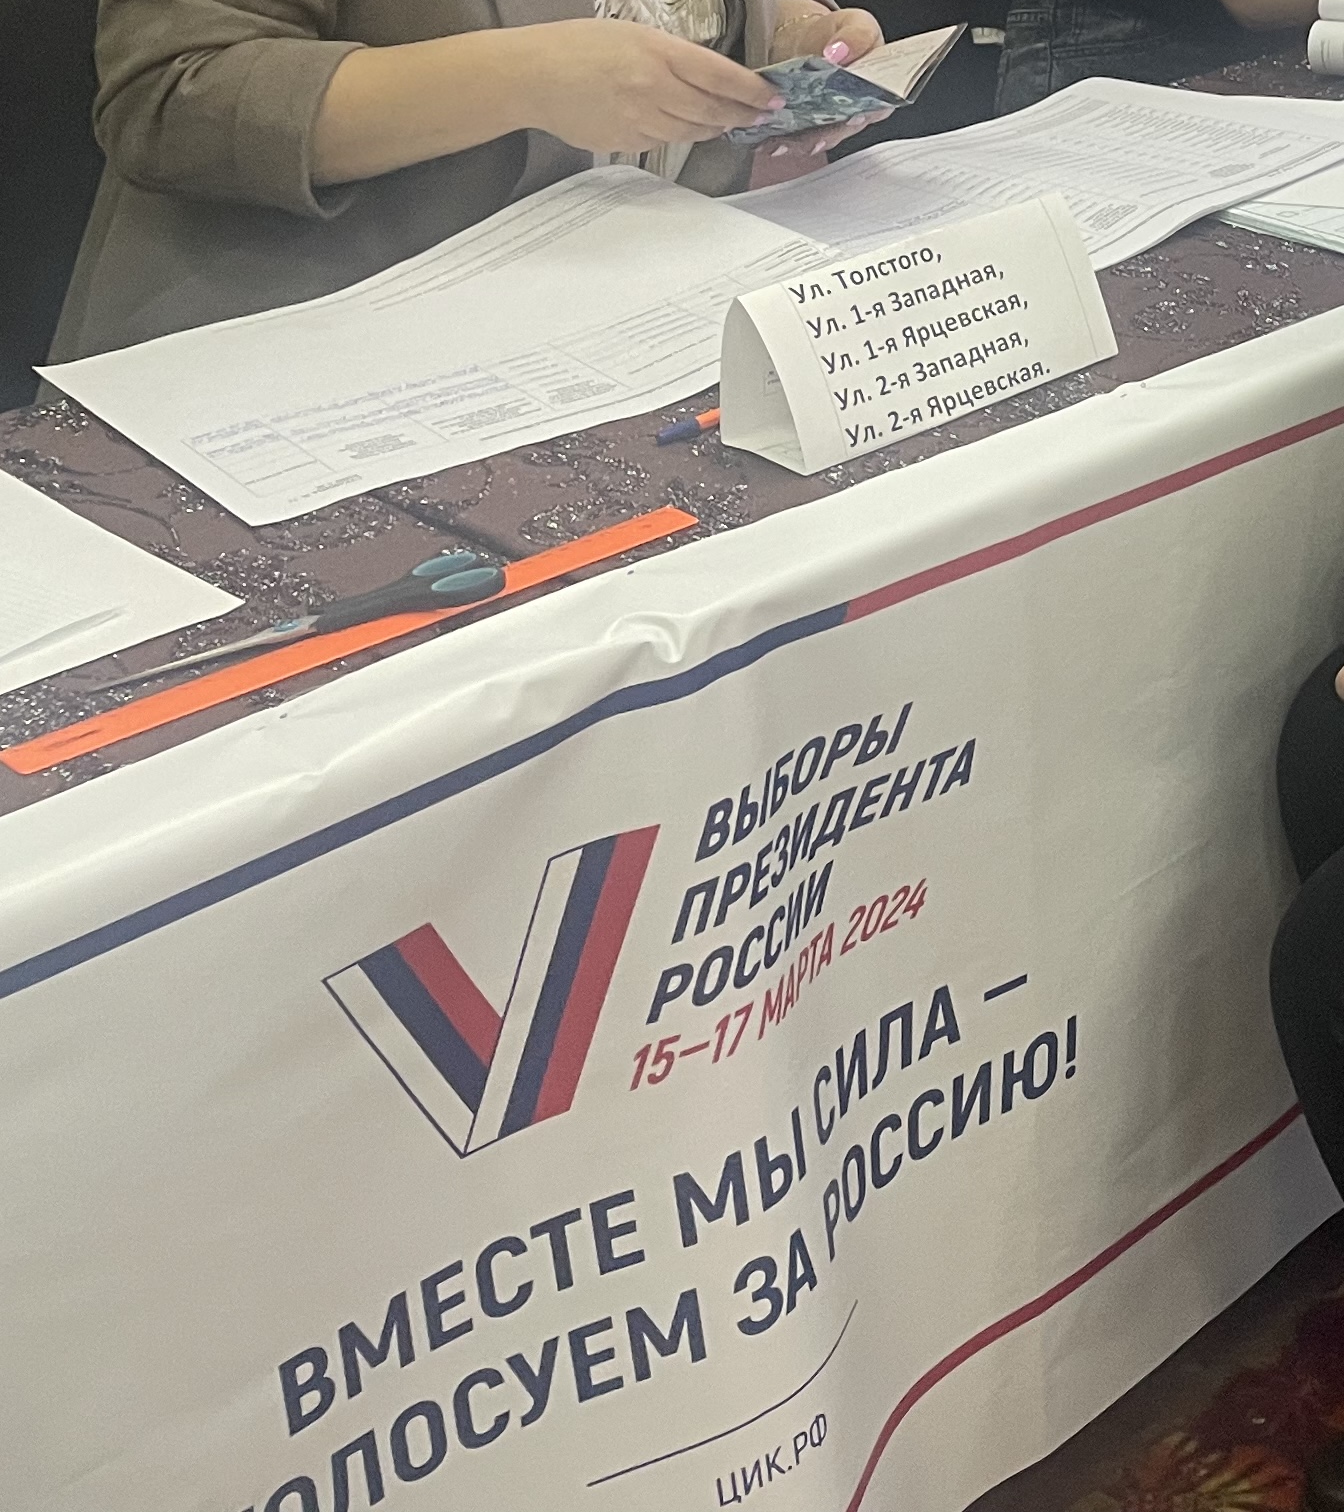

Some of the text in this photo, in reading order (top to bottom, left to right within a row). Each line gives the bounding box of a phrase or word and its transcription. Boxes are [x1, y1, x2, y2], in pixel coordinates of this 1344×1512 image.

[788, 247, 942, 304] Ул. Толстого,
[806, 264, 1004, 339] Ул. 1-я Западная,
[821, 294, 1028, 375] Ул. 1-я Ярцевская,
[834, 332, 1029, 411] Ул. 2-я Западная,
[845, 361, 1050, 448] Ул. 2-я Ярцевская.
[671, 738, 976, 944] ПРЕЗИДЕНТА
[694, 701, 913, 863] ВЫБОРЫ
[645, 859, 834, 1026] РОССИИ
[758, 922, 834, 1041] МАРТА
[840, 878, 928, 956] 2024
[278, 1189, 646, 1437] ВМЕСТЕ
[673, 1106, 806, 1249] МЫ
[813, 985, 961, 1146] СИЛА
[733, 1227, 818, 1336] ЗА
[822, 1014, 1077, 1263] РОССИЮ!
[715, 1413, 829, 1507] ЦИК.РФ
